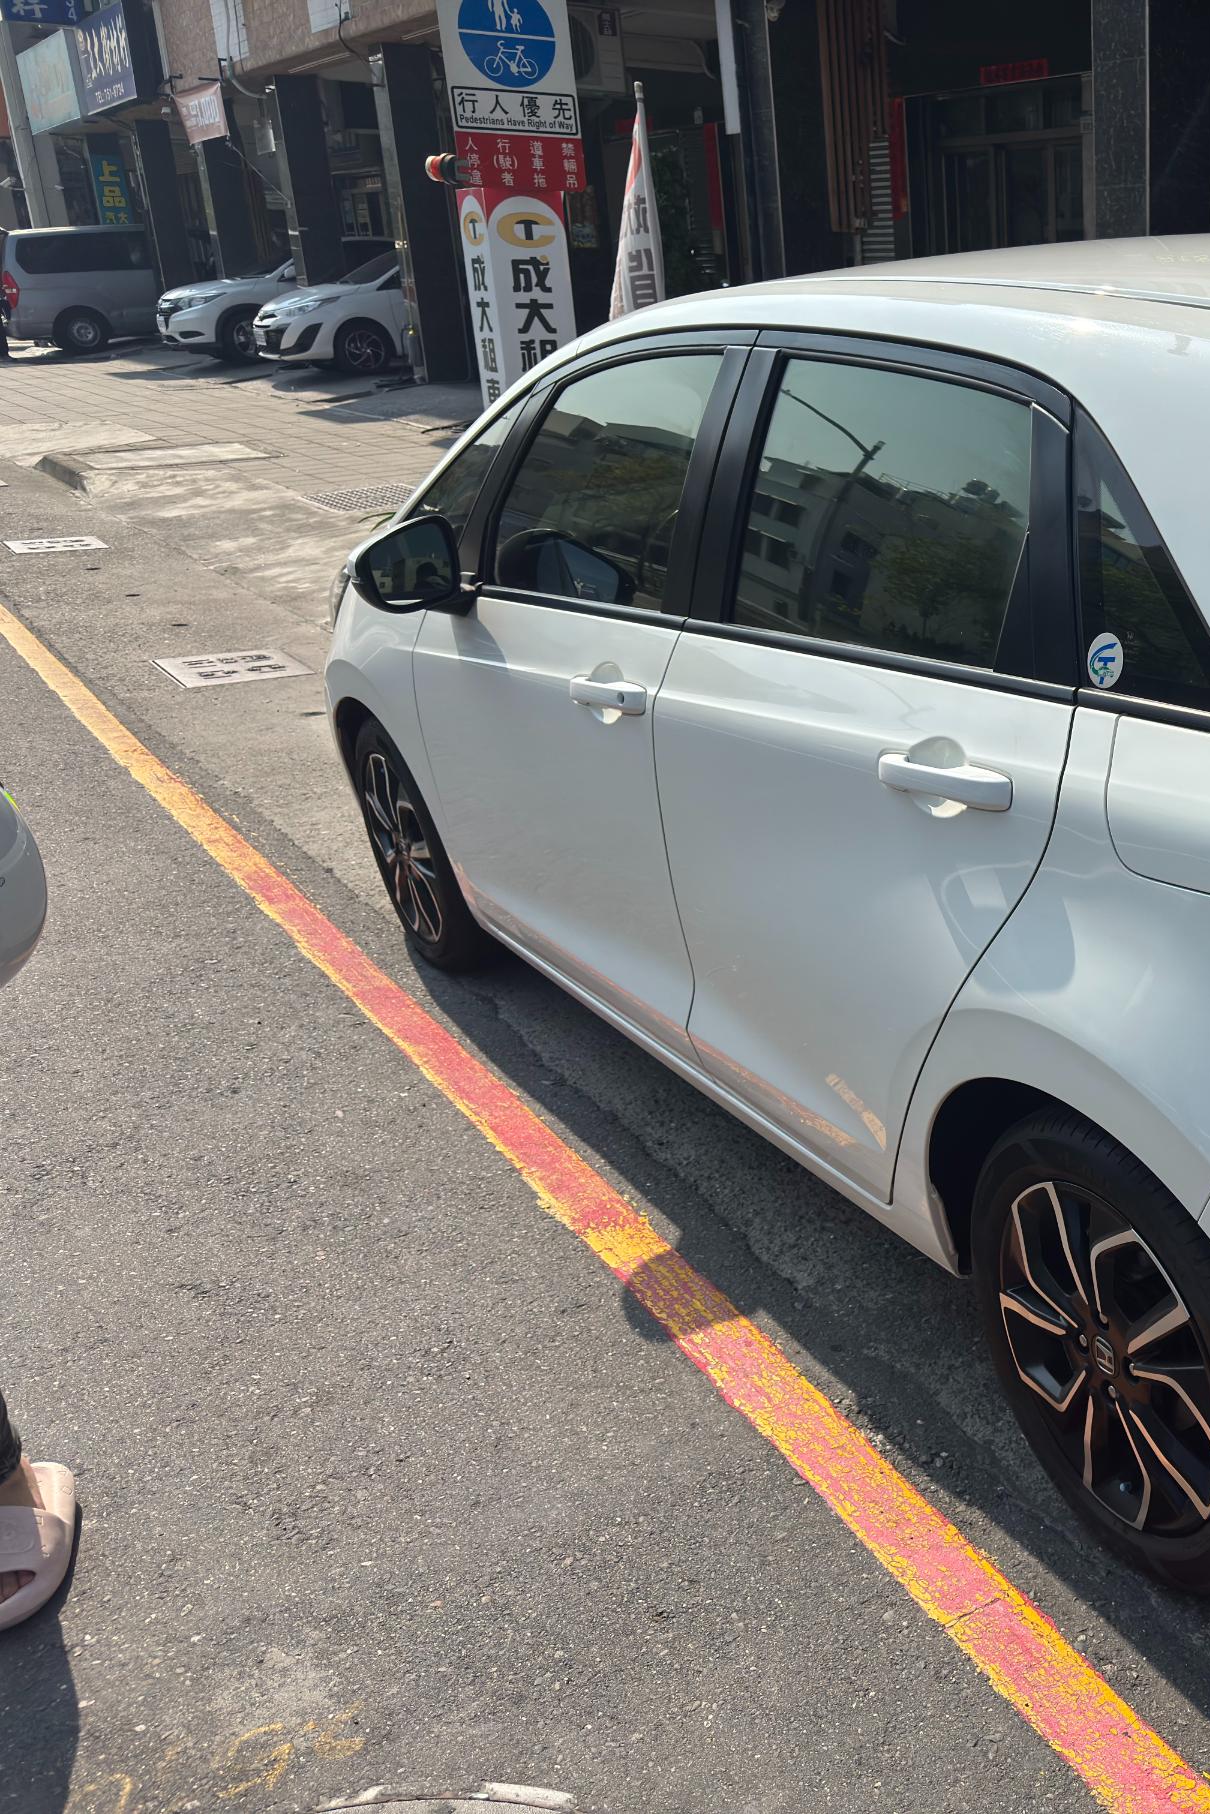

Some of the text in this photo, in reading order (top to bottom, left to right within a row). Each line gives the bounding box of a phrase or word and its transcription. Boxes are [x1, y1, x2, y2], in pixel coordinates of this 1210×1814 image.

[457, 91, 573, 121] 行人優先
[459, 114, 574, 132] Pedestrians Have Right of Way
[99, 160, 126, 208] 上品
